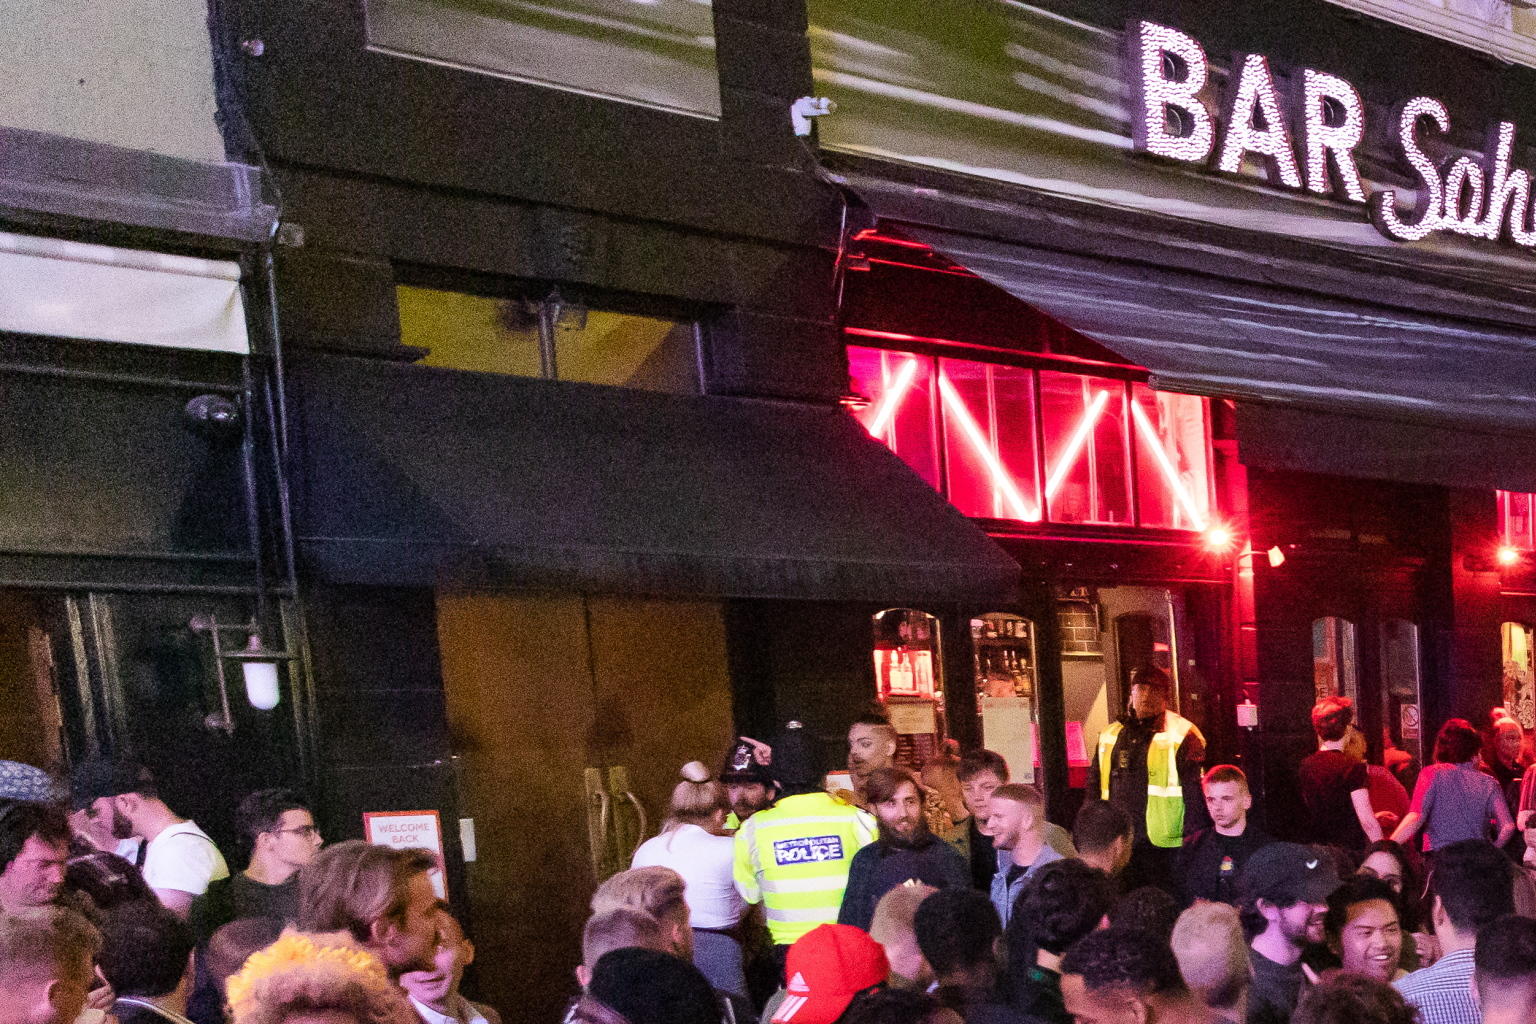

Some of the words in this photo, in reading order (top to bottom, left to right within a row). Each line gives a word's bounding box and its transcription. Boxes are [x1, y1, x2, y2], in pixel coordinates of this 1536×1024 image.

[1140, 20, 1367, 204] BAR
[378, 823, 430, 832] WELCOME
[392, 834, 419, 843] BACK
[776, 844, 841, 862] POLICE
